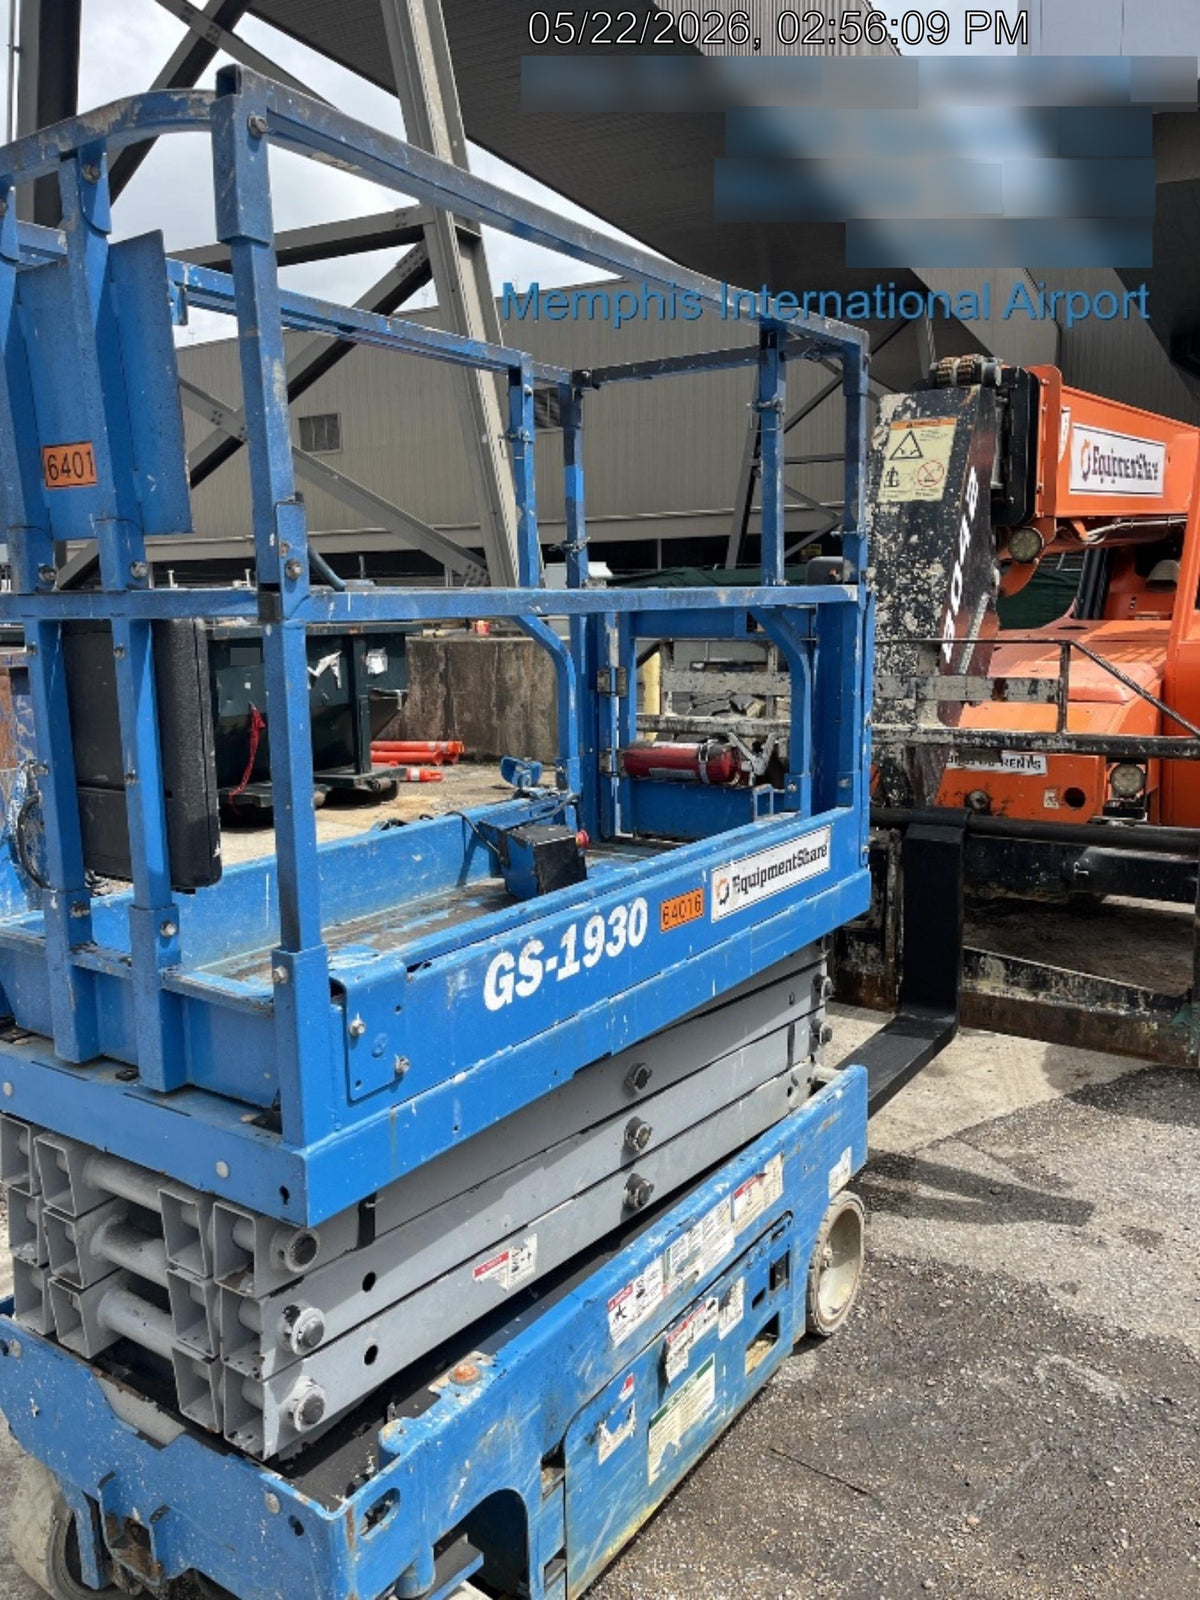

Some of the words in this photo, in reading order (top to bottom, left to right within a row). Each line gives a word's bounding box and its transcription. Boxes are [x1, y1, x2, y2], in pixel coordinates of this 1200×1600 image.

[731, 843, 828, 895] EquipmentShare
[662, 893, 702, 926] 64016
[483, 897, 648, 1012] GS-1930
